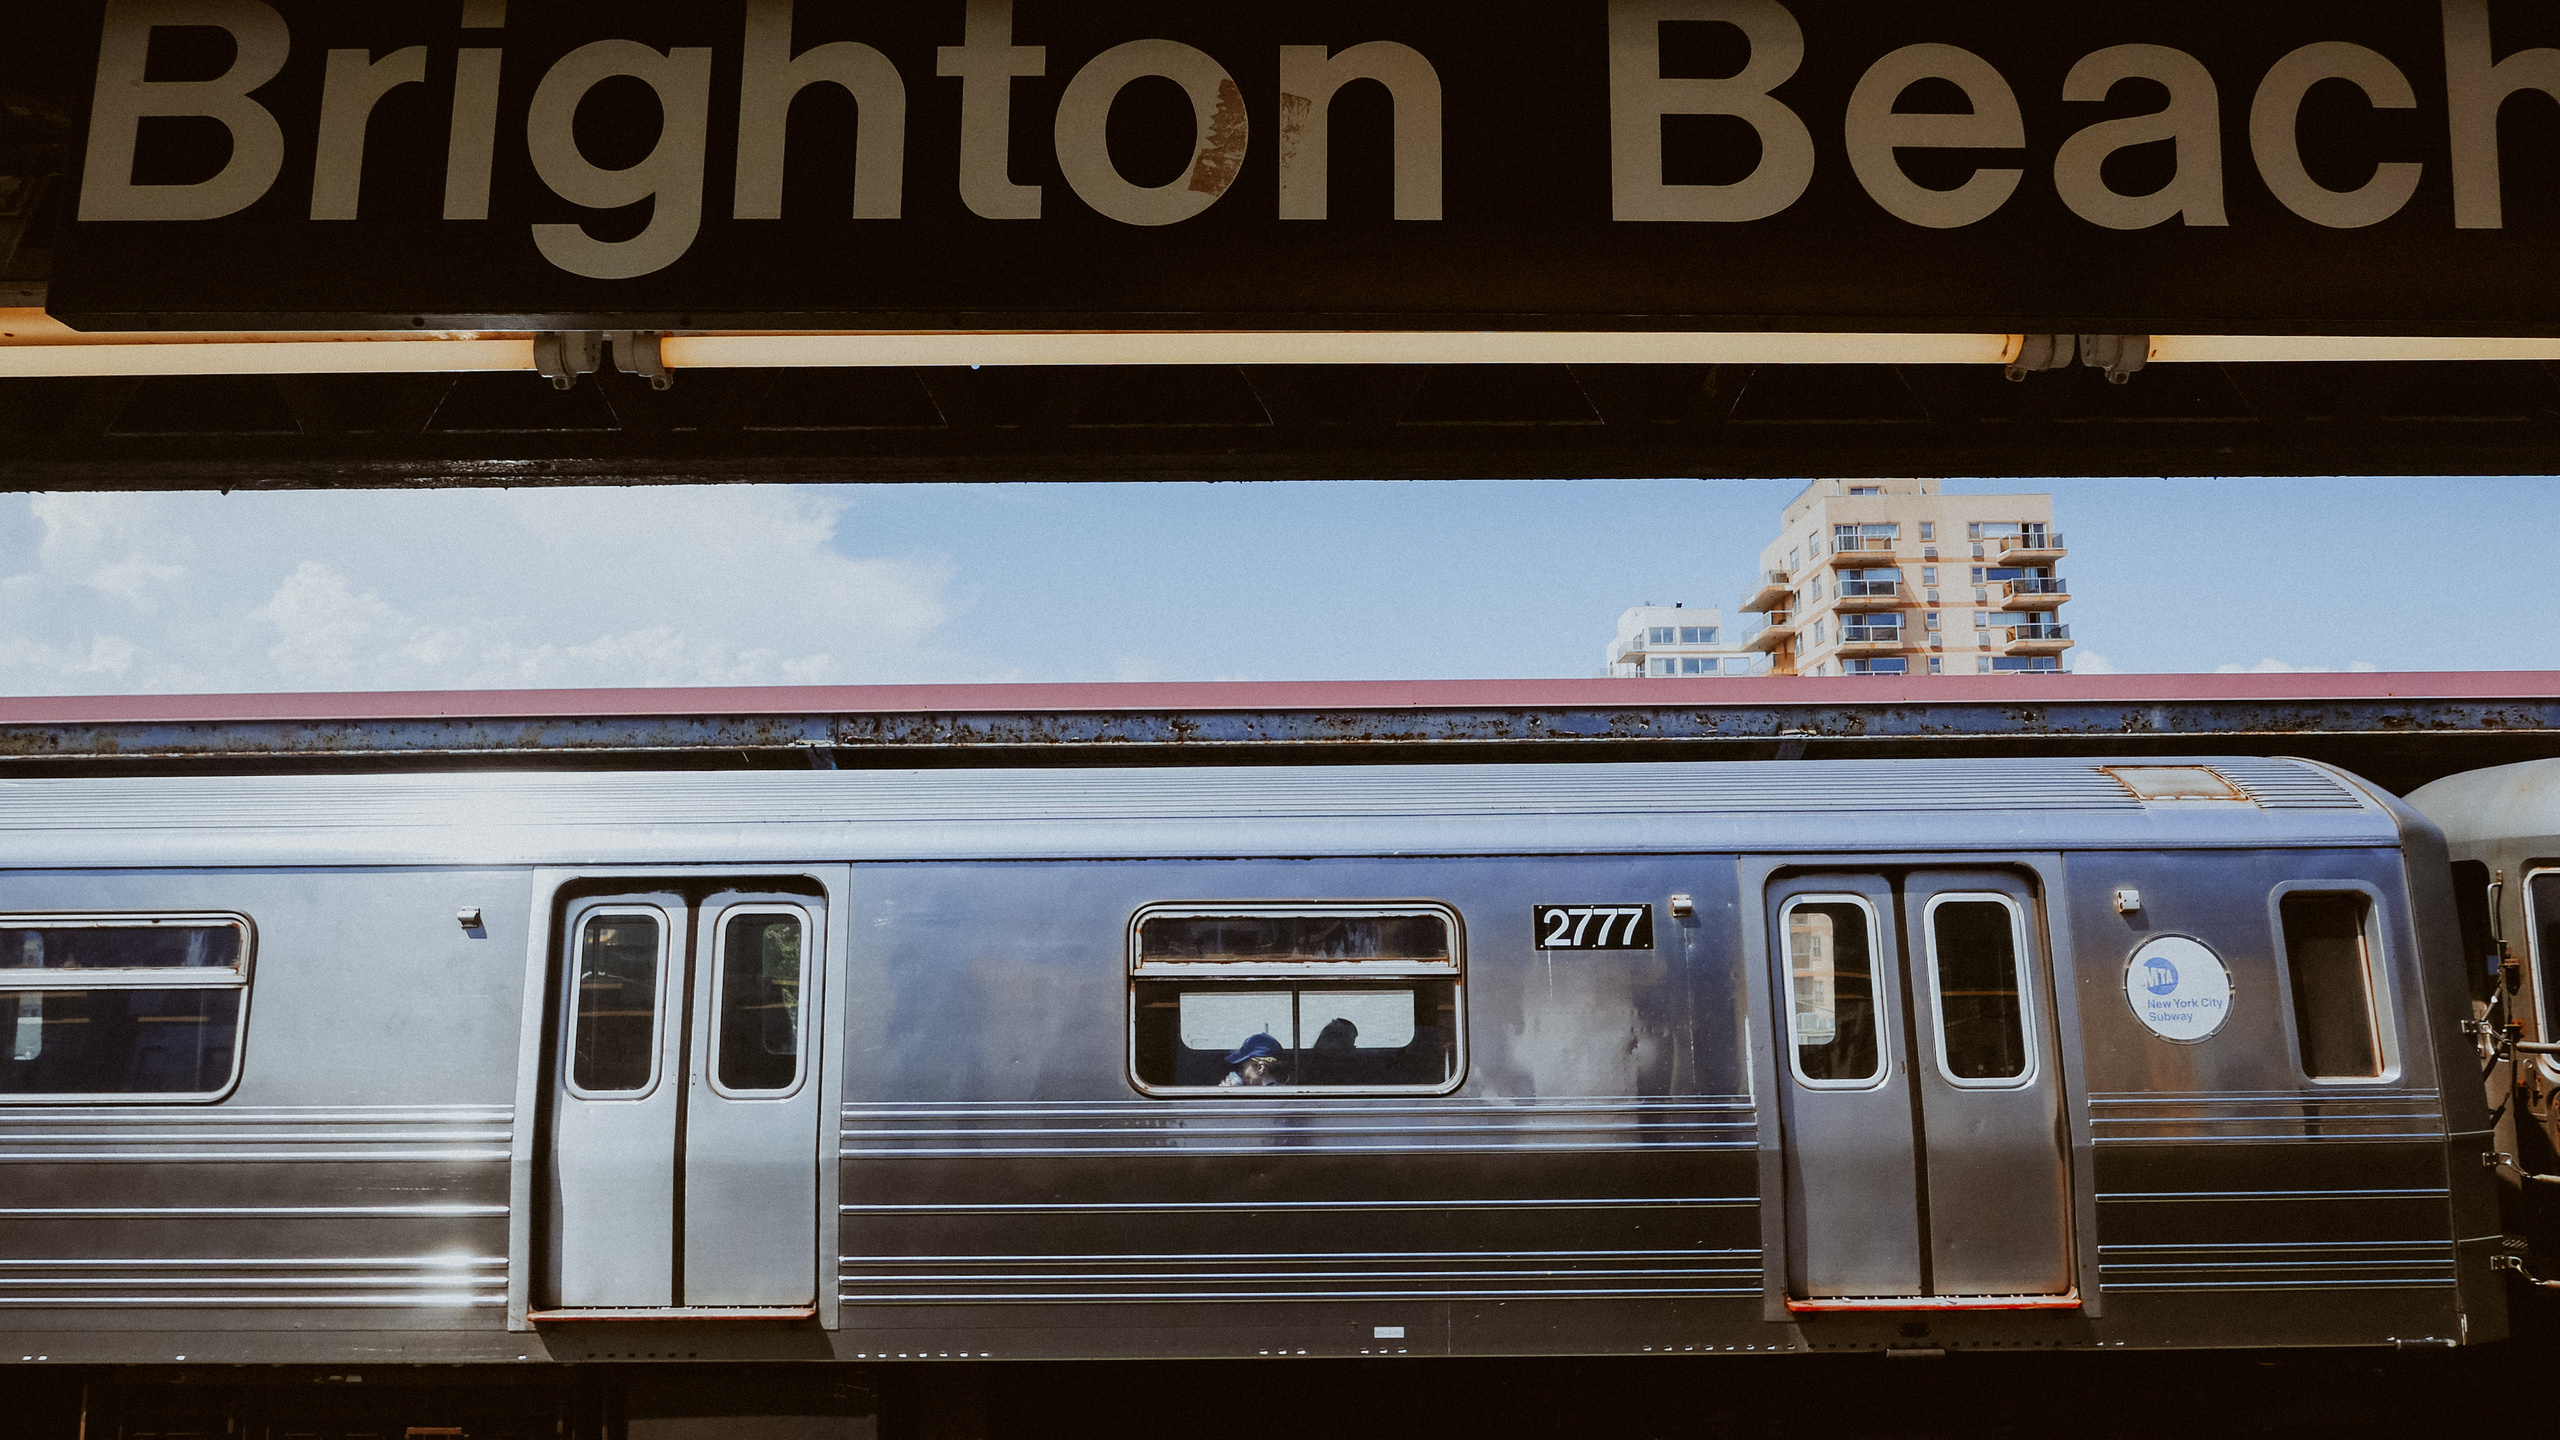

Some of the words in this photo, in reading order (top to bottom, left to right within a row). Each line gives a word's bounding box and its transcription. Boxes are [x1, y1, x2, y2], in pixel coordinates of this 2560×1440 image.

[77, 0, 1444, 280] Brighton
[1543, 908, 1643, 947] 2777
[2143, 966, 2176, 989] MTA
[2147, 999, 2172, 1009] New
[2173, 998, 2199, 1009] York
[2200, 997, 2223, 1010] City
[2148, 1011, 2193, 1023] Subway
